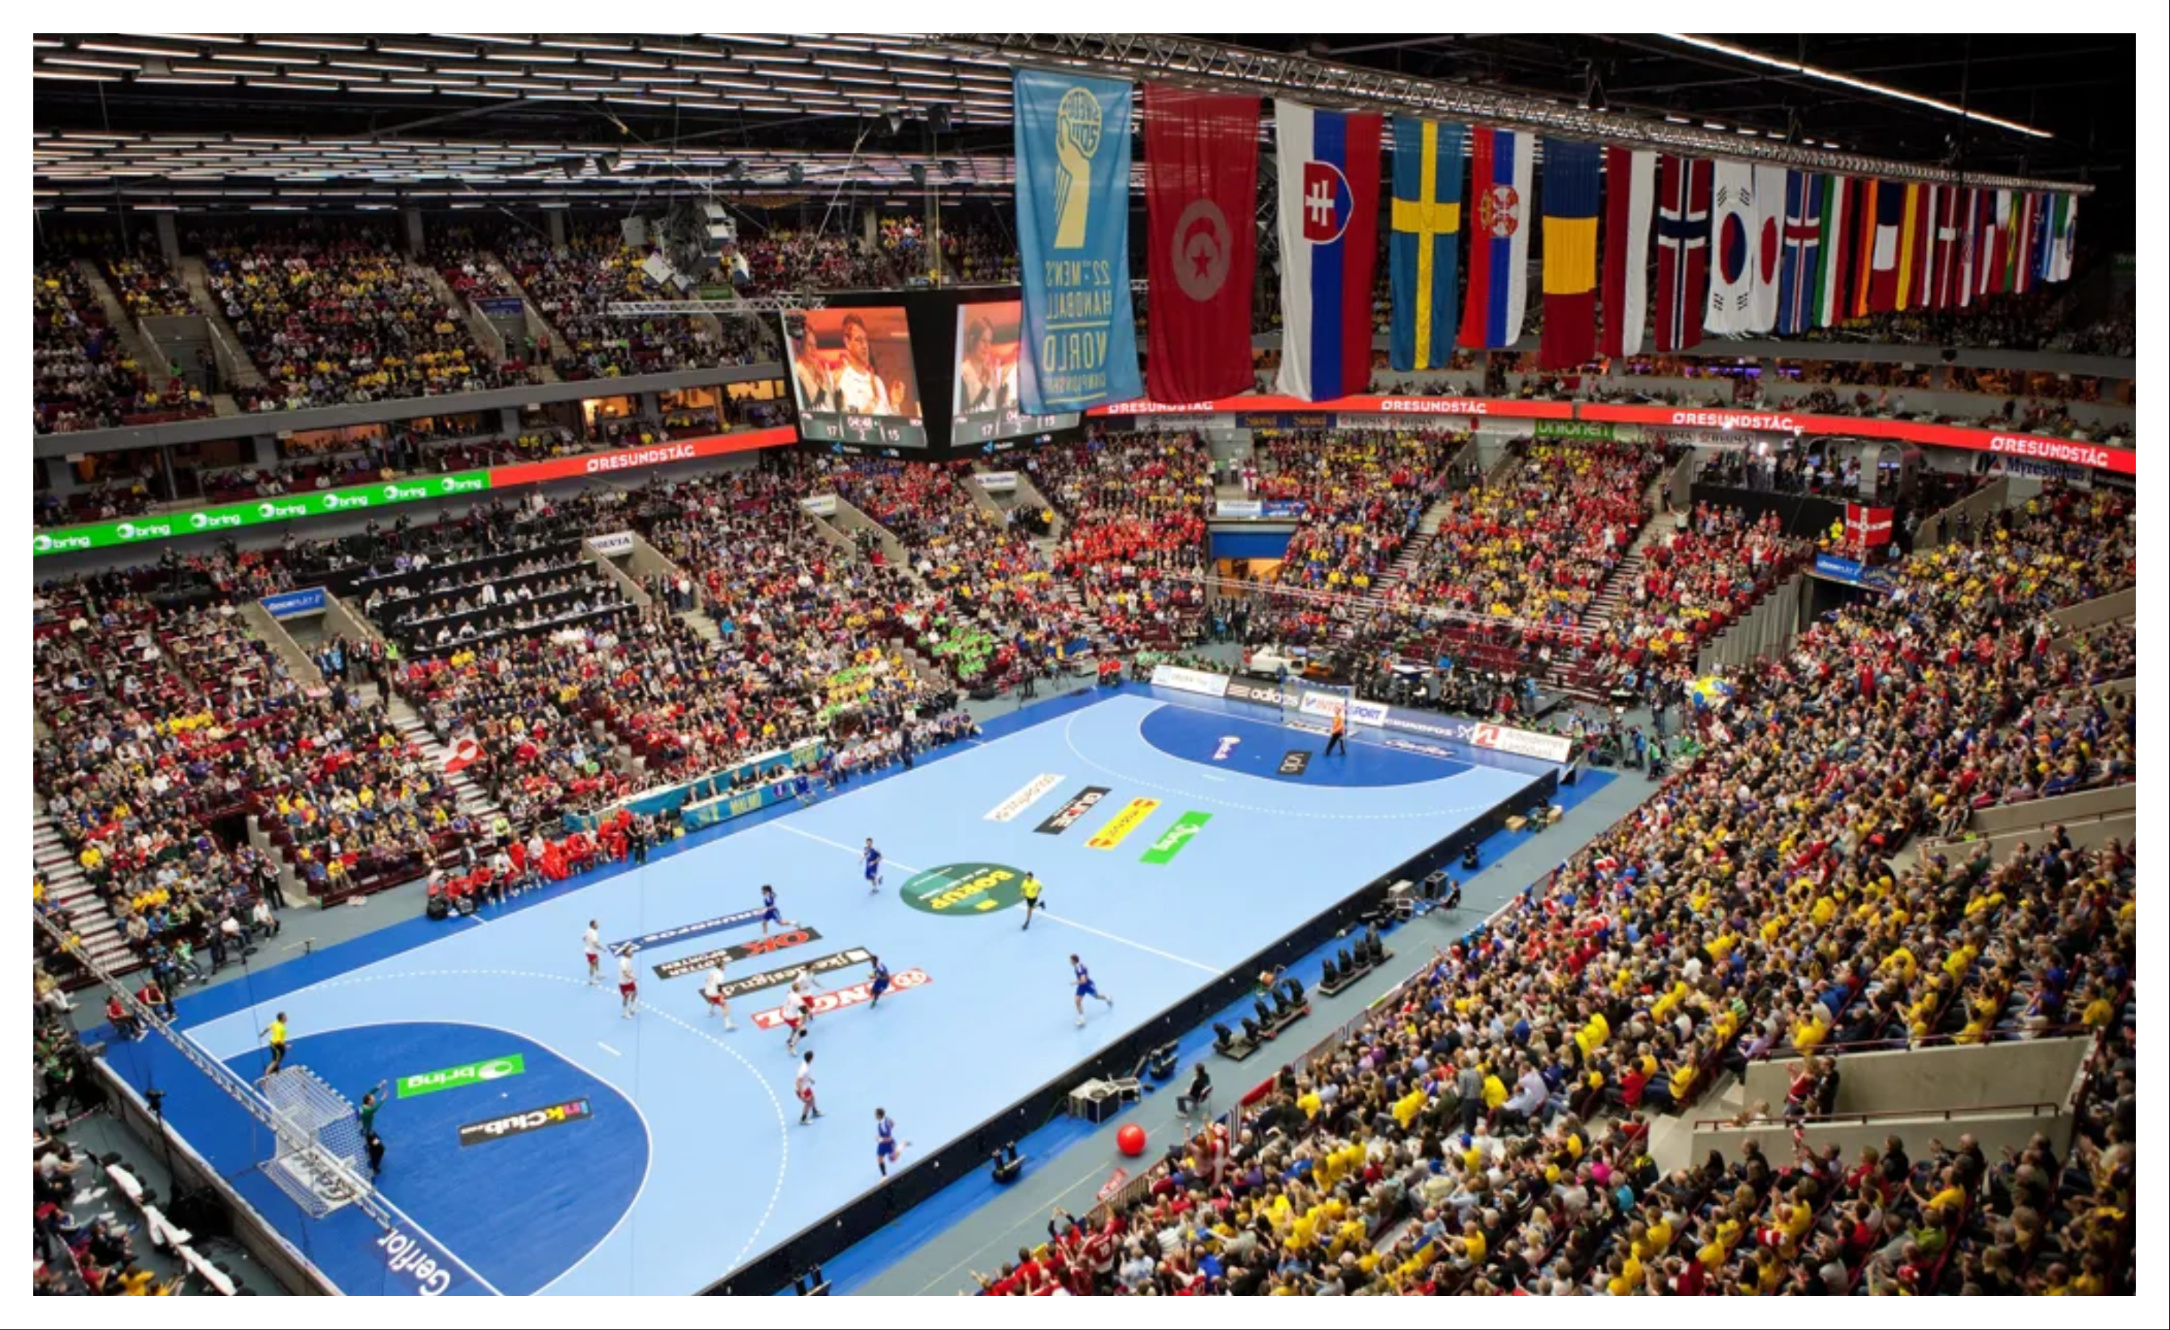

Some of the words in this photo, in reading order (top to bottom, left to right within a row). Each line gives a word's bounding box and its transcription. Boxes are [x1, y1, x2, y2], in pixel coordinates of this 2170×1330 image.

[1381, 400, 1487, 414] ØRESUNDSTÅG
[826, 425, 837, 436] 17
[888, 429, 900, 441] 15
[981, 423, 993, 436] 17
[1990, 436, 2109, 466] ØRESUNDSTÅG
[586, 445, 695, 472] ØRESUNDSTÅG
[454, 477, 482, 489] bring
[399, 486, 426, 498] bring
[339, 494, 368, 506] bring
[275, 503, 306, 515] bring
[207, 513, 241, 526] bring
[135, 524, 171, 536] bring
[52, 535, 91, 548] bring
[930, 867, 1014, 909] BORUP
[741, 928, 810, 957] OK
[407, 1066, 475, 1089] bring
[377, 1228, 451, 1296] Gerflor
